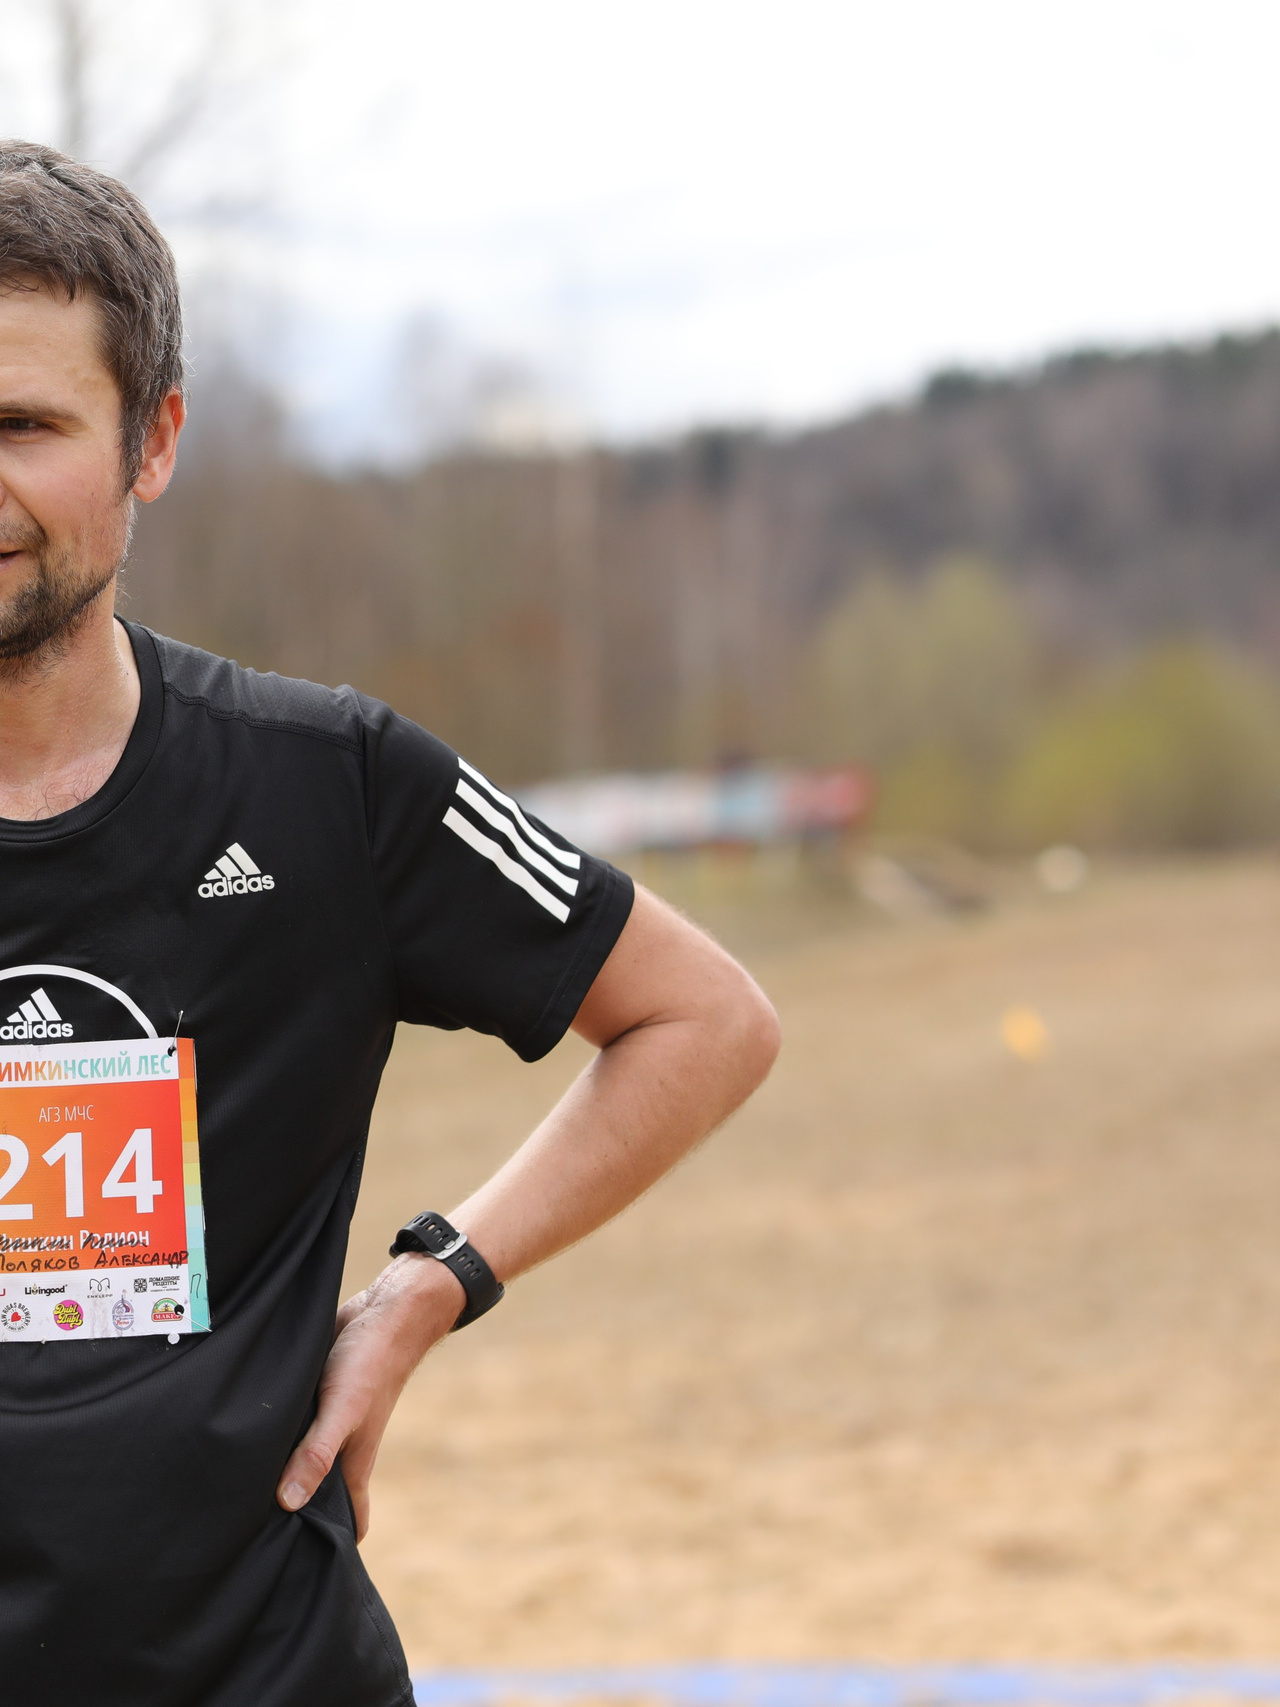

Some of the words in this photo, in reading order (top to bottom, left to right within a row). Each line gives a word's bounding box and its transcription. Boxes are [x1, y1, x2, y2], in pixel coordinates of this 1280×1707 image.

[198, 874, 275, 898] adidas
[0, 1020, 74, 1040] adidas
[136, 1053, 171, 1075] ЛЕС
[38, 1106, 61, 1122] АГЗ
[65, 1105, 95, 1121] МЧС
[24, 1284, 66, 1296] Livingood
[18, 1303, 31, 1326] BREWERY
[53, 1303, 79, 1315] Dubl
